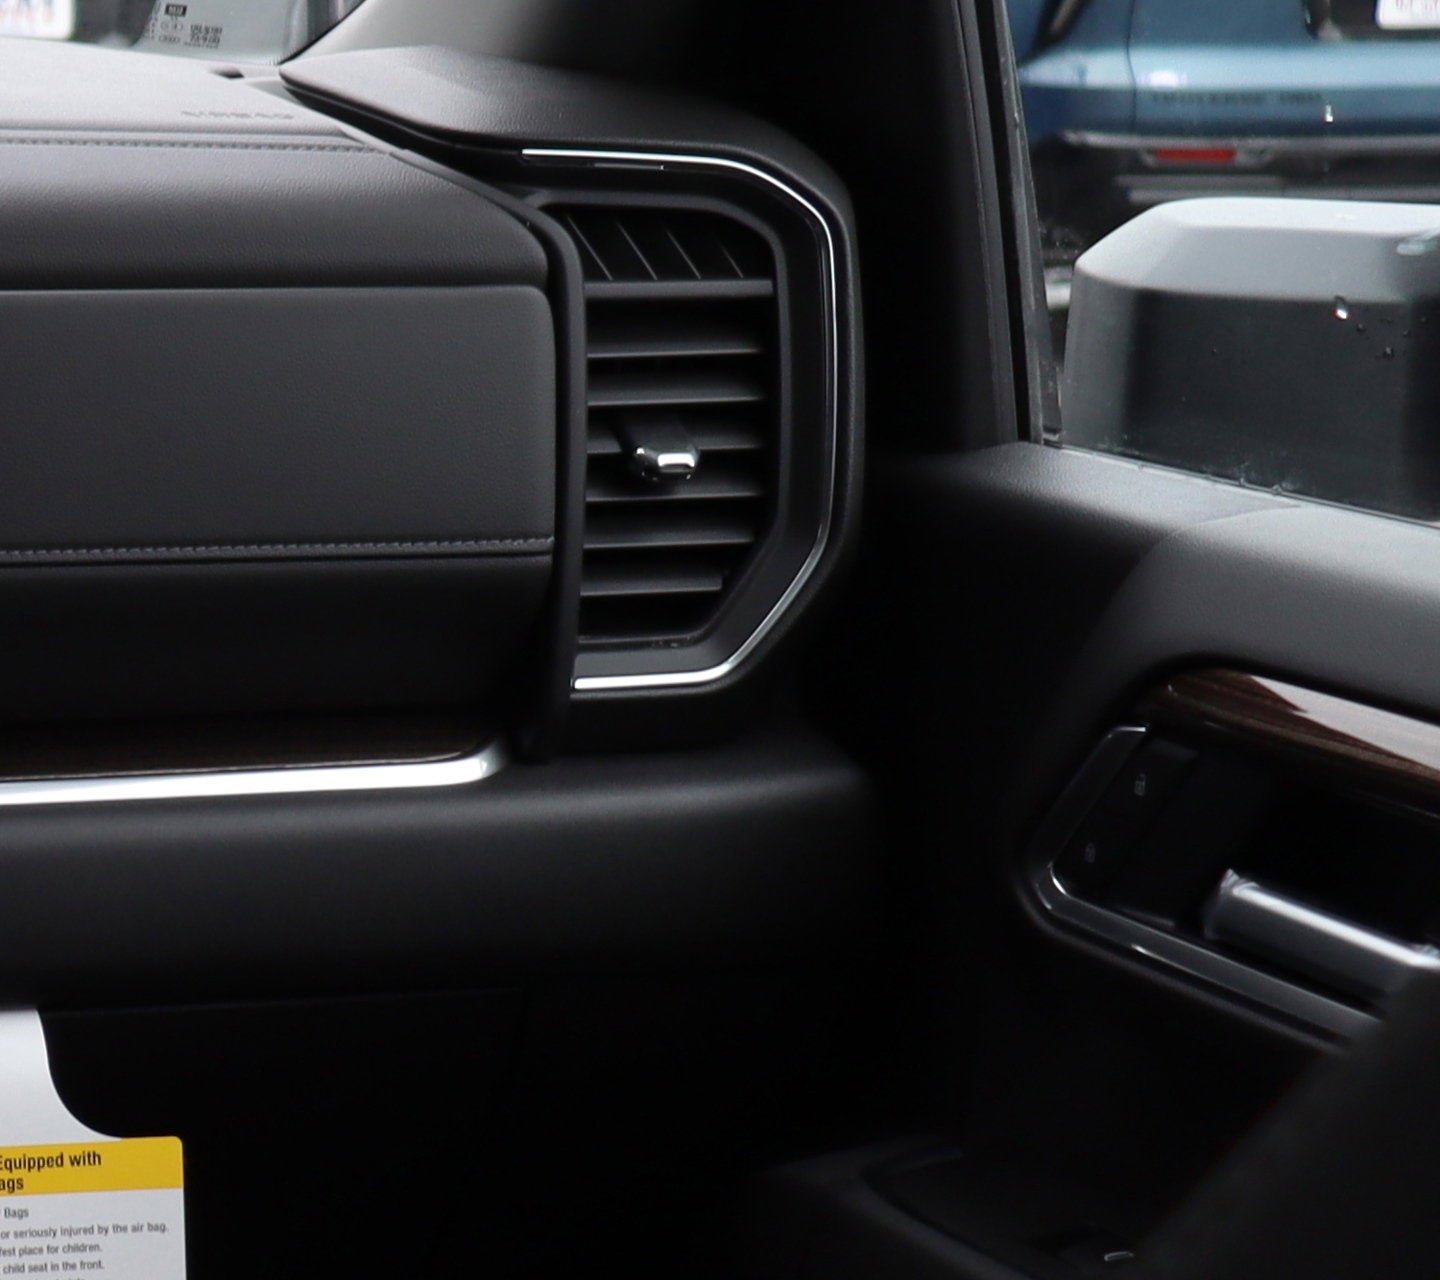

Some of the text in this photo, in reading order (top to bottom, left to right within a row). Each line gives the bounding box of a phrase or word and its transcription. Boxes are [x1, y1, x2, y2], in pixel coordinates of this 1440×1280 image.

[69, 1150, 102, 1167] with
[4, 1207, 29, 1219] Bags
[0, 1230, 11, 1240] or
[13, 1227, 57, 1239] seriously
[60, 1225, 94, 1238] injured
[97, 1225, 109, 1236] by
[112, 1223, 128, 1233] the
[131, 1222, 144, 1233] air
[147, 1221, 168, 1233] bag.
[18, 1246, 44, 1258] place
[46, 1244, 59, 1254] for
[62, 1242, 103, 1253] children.
[3, 1263, 26, 1274] child
[28, 1263, 48, 1273] seat
[50, 1262, 60, 1272] in
[62, 1261, 77, 1271] the
[80, 1259, 104, 1270] front.
